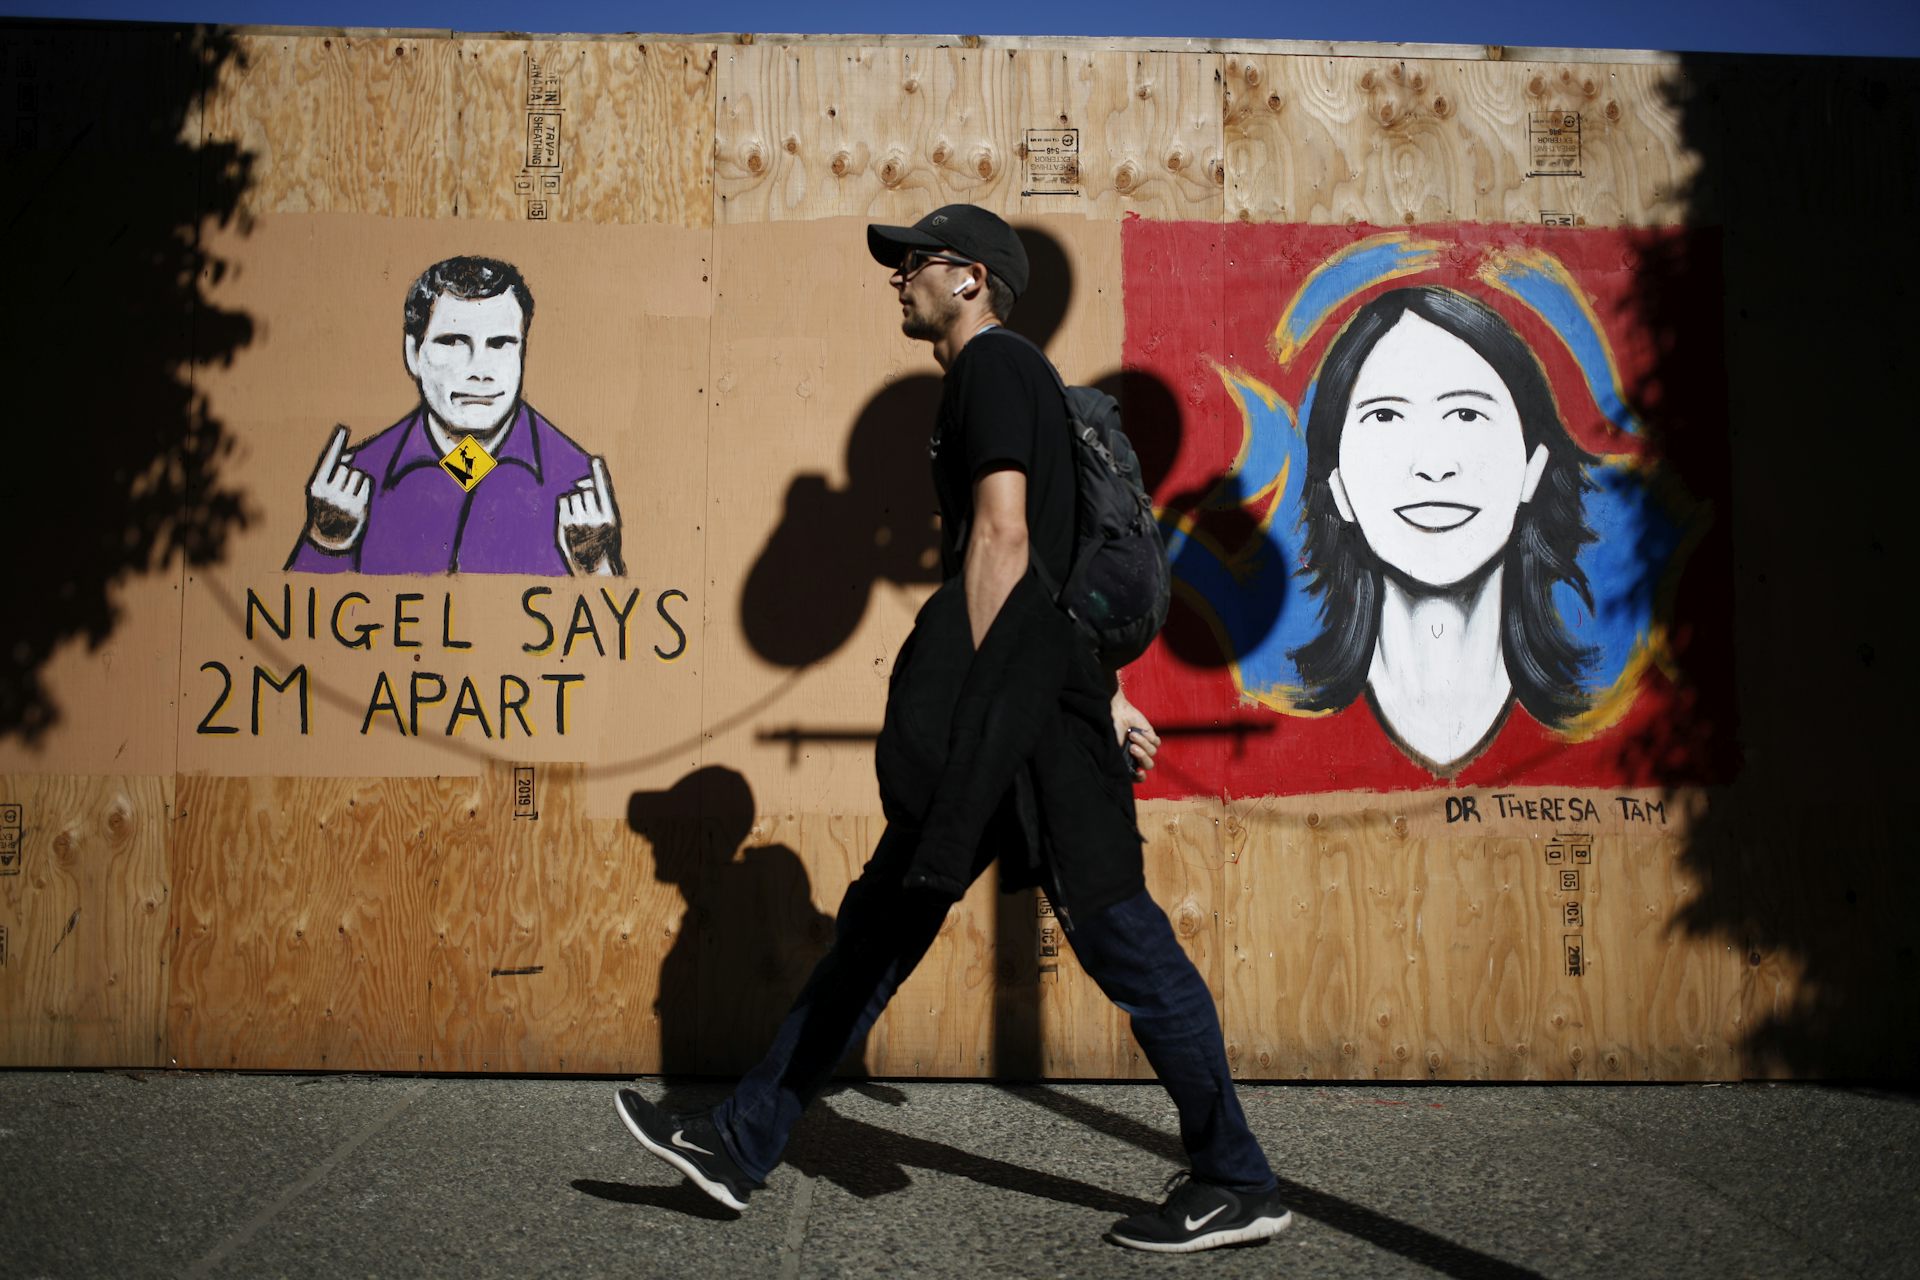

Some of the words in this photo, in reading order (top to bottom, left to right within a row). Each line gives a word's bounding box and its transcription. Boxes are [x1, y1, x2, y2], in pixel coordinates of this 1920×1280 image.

[531, 58, 543, 101] ANADA
[532, 116, 543, 165] SHEATHING
[1030, 163, 1072, 171] HEATHING
[1034, 155, 1071, 163] EXTERIOR
[246, 583, 473, 650] NIGEL
[522, 586, 689, 661] SAYS
[196, 660, 308, 736] 2M
[360, 670, 585, 740] APART
[518, 779, 531, 806] 2019
[1445, 796, 1482, 824] DR
[1492, 793, 1601, 823] THERESA
[1616, 797, 1667, 825] TAM
[1563, 873, 1576, 888] 05
